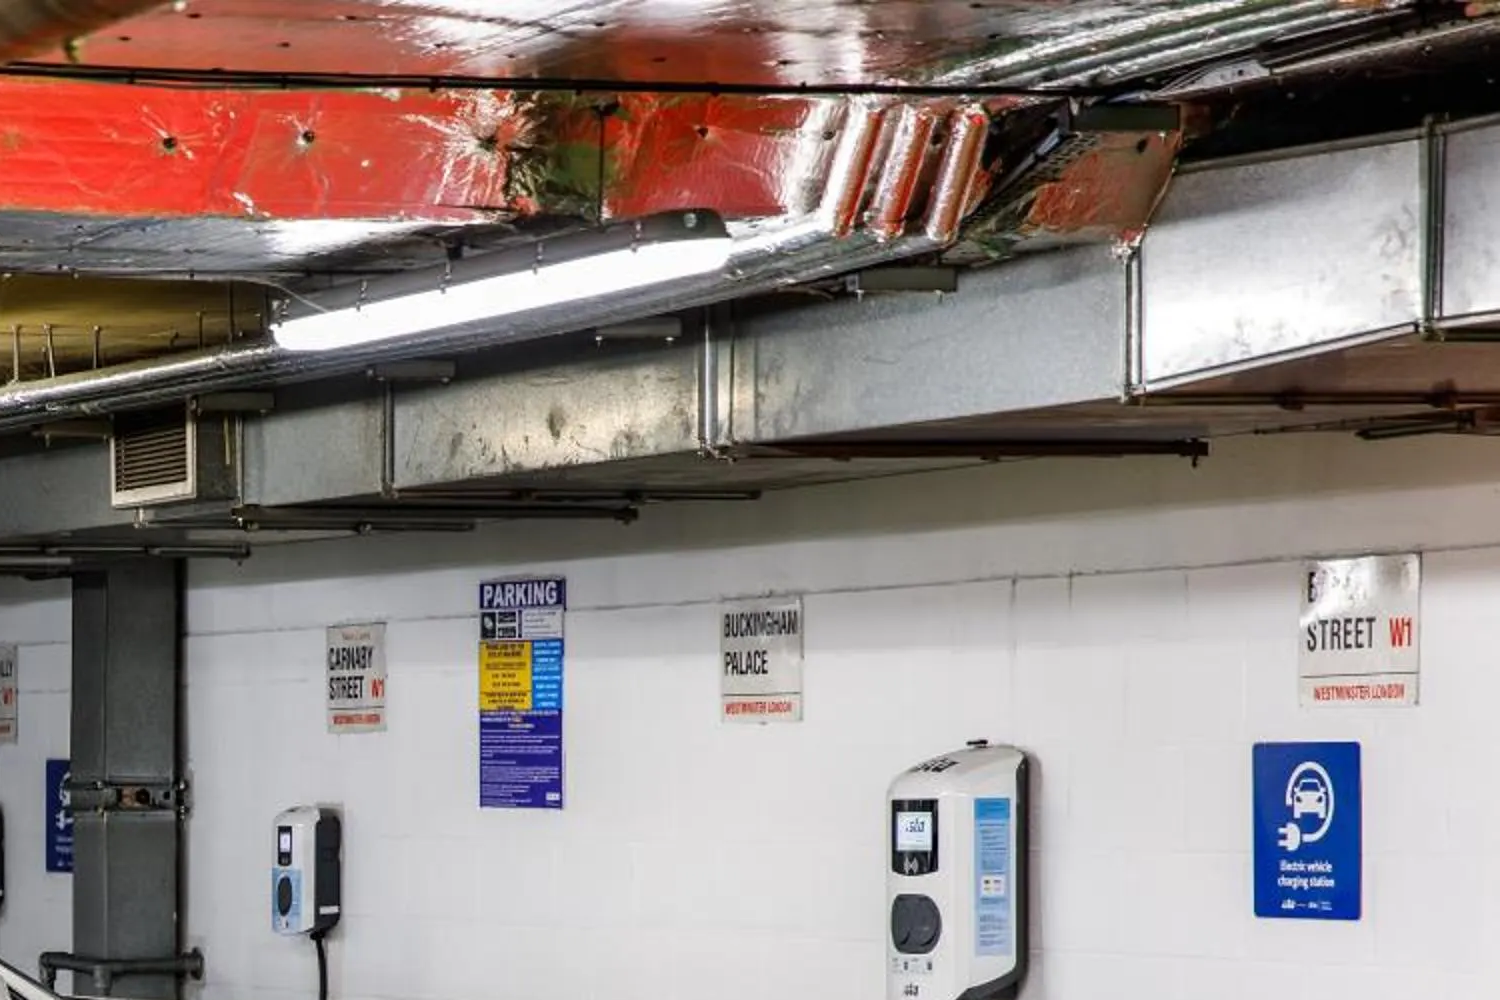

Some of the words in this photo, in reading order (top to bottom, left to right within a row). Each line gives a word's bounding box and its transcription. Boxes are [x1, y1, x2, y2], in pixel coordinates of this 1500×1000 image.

[483, 582, 558, 607] PARKING
[724, 609, 799, 638] BUCKINGHAM
[1307, 617, 1377, 652] STREET
[1389, 617, 1412, 648] W1
[329, 645, 374, 670] CARNABY
[724, 650, 769, 676] PALACE
[329, 675, 364, 700] STREET
[1314, 684, 1371, 701] WESTMINSTER
[1372, 683, 1405, 700] LONDON
[1307, 860, 1333, 873] vehicle
[1310, 875, 1335, 888] station
